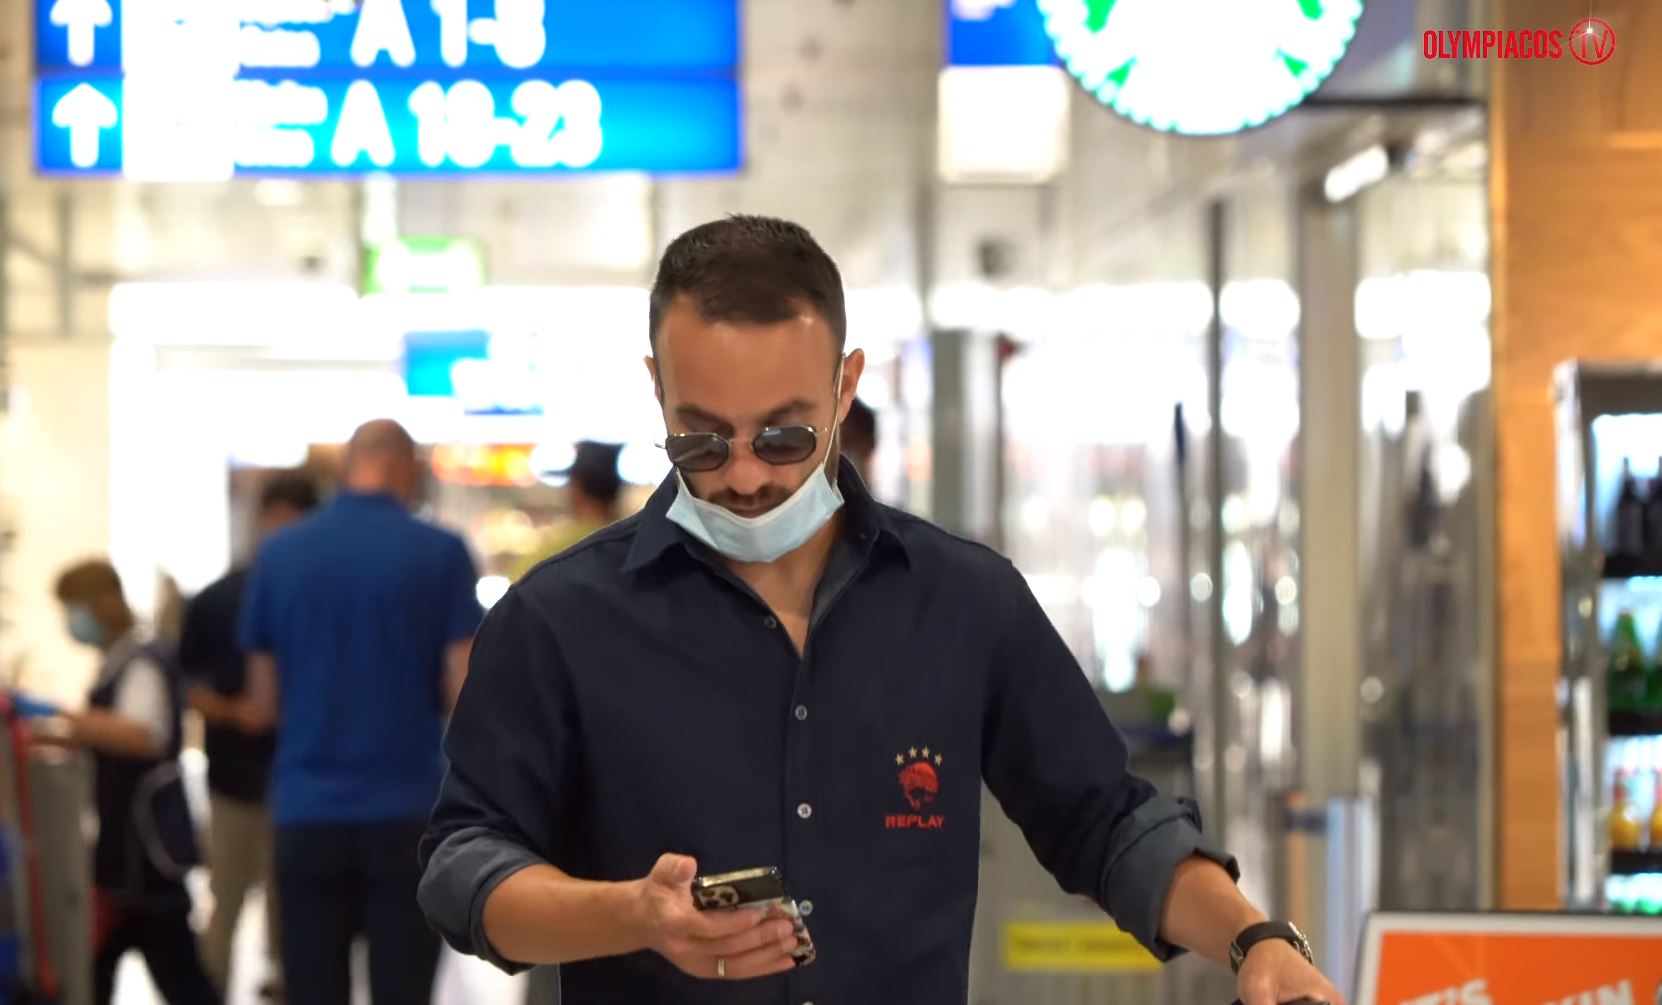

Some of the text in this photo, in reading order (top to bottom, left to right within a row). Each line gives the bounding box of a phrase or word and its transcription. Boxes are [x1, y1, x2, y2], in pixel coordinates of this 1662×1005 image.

[350, 0, 415, 67] A
[330, 80, 396, 167] A
[885, 814, 944, 829] REPLAY
